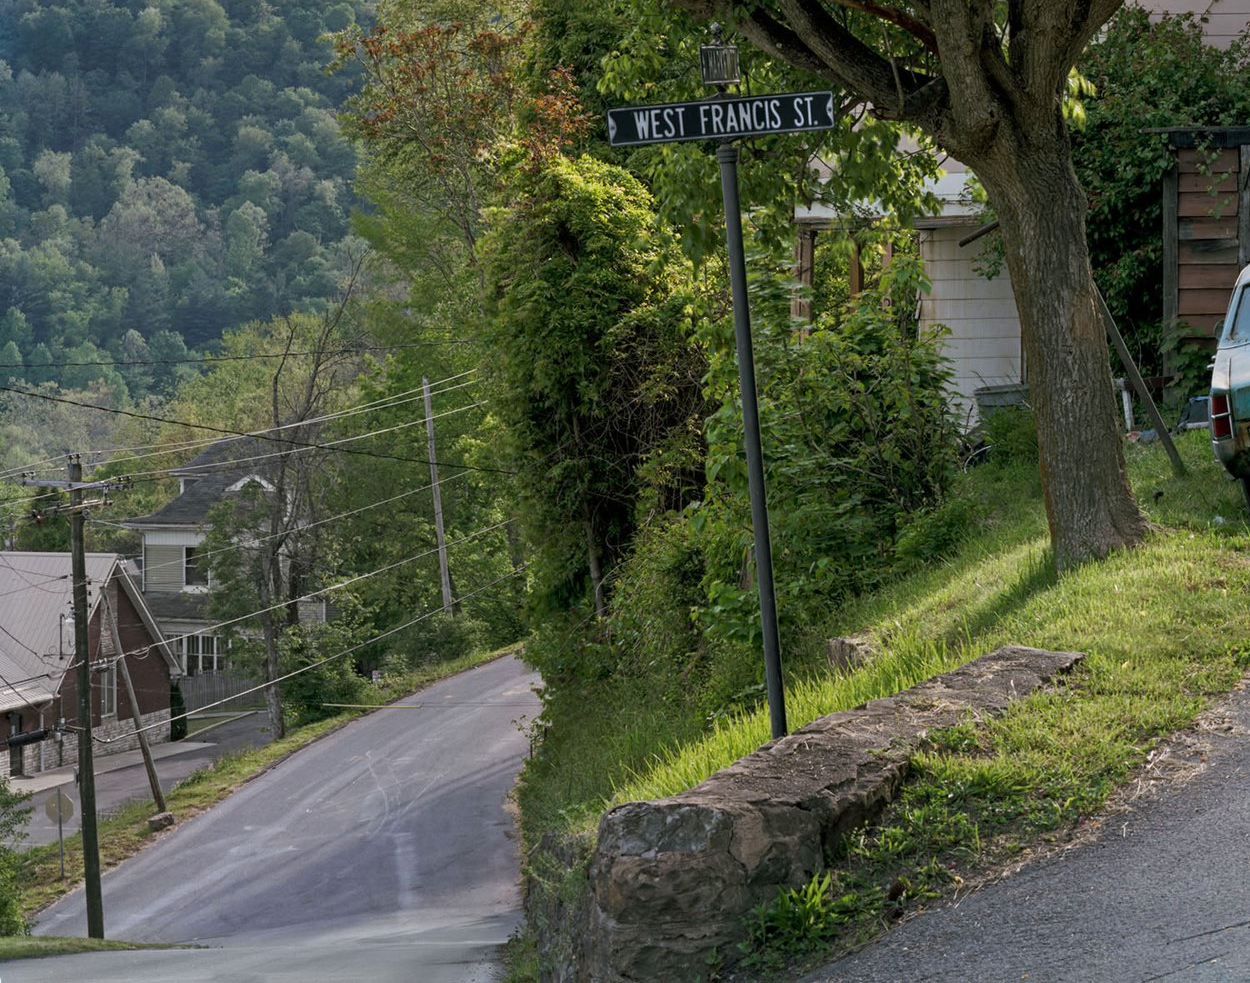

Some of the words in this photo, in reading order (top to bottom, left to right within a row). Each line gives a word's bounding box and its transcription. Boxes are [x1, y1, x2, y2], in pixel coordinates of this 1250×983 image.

[634, 108, 686, 139] WEST
[699, 100, 782, 135] FRANCIS
[793, 97, 819, 127] ST.
